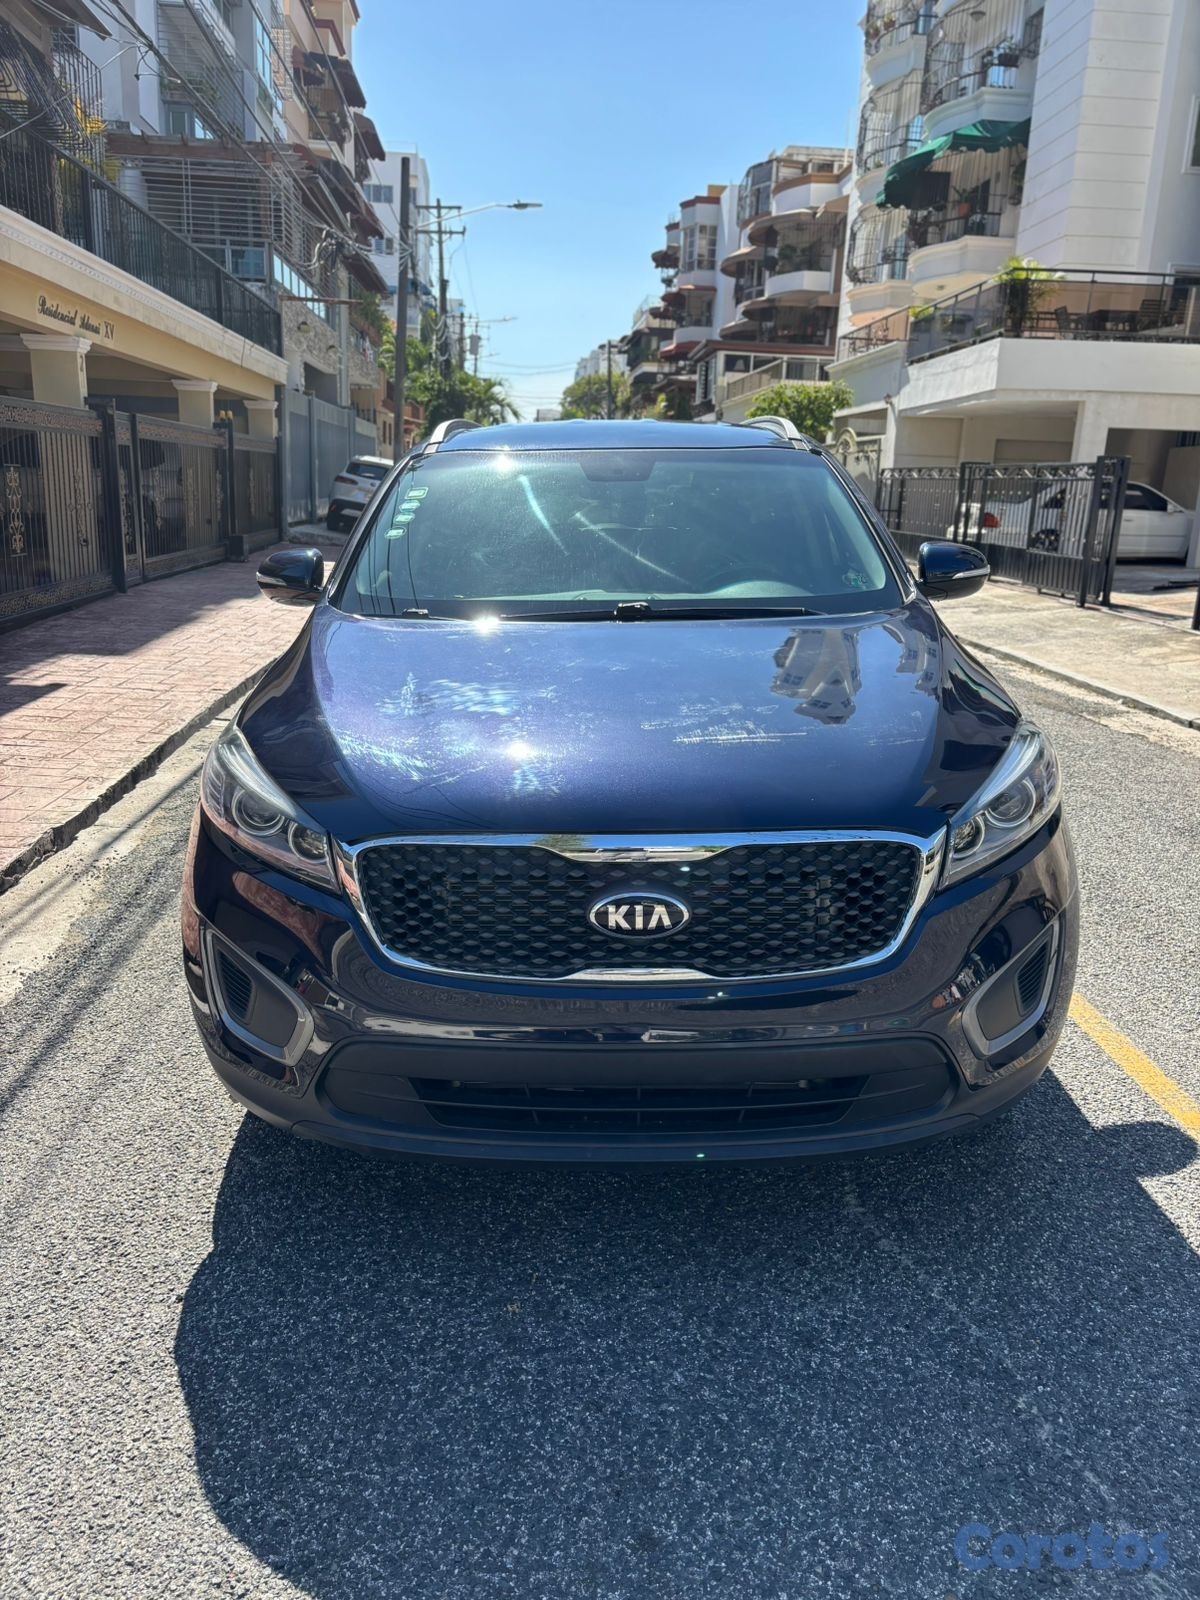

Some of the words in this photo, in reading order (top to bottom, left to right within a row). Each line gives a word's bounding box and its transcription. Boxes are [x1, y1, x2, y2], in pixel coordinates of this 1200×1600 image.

[38, 295, 78, 326] Residencial
[103, 321, 115, 340] XV
[606, 904, 673, 930] KIA
